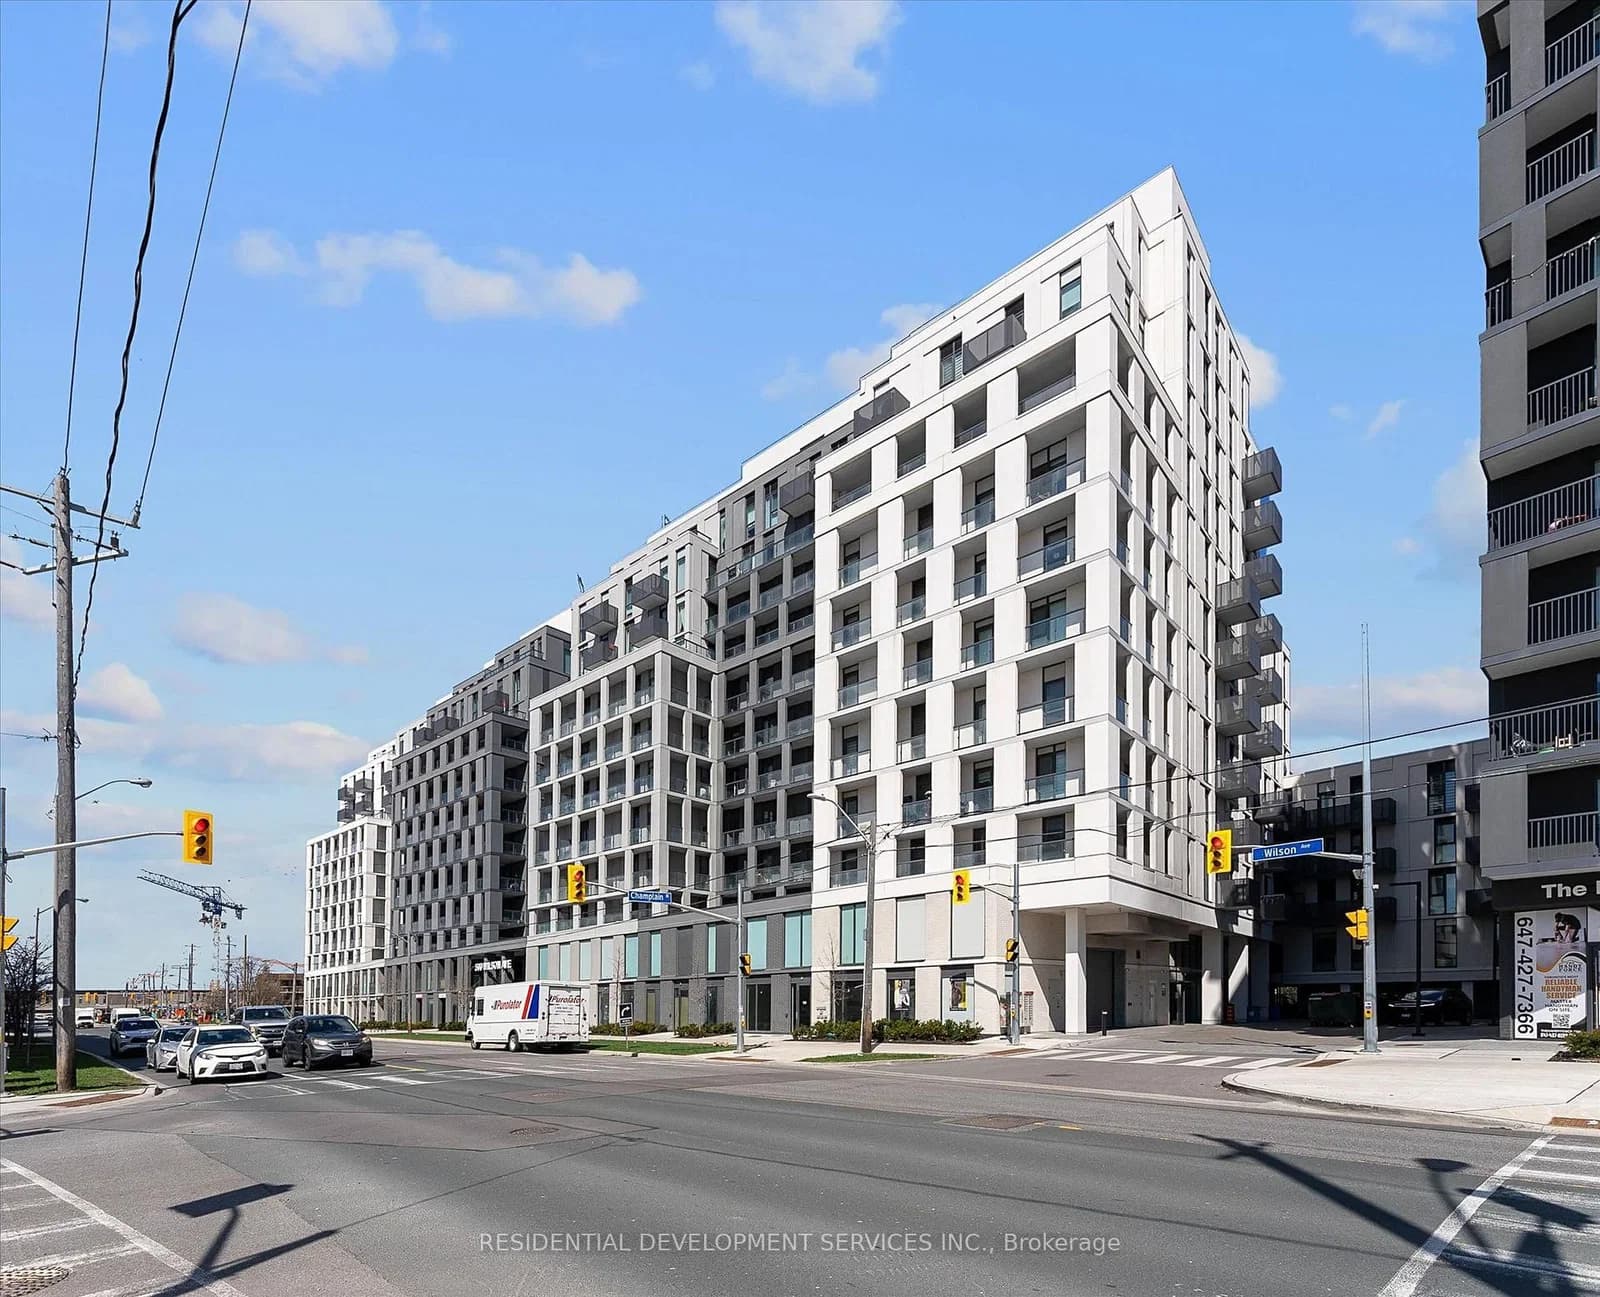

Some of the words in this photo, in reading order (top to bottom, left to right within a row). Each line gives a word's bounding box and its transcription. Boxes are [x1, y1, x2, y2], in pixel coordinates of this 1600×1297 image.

[1264, 846, 1297, 858] Wilson
[630, 891, 664, 902] Champlain
[1541, 883, 1588, 899] The
[1517, 917, 1534, 1034] 647-427-7366
[1541, 985, 1582, 993] HANDYMAN
[495, 999, 522, 1010] Purolator
[551, 995, 584, 1004] Purolator
